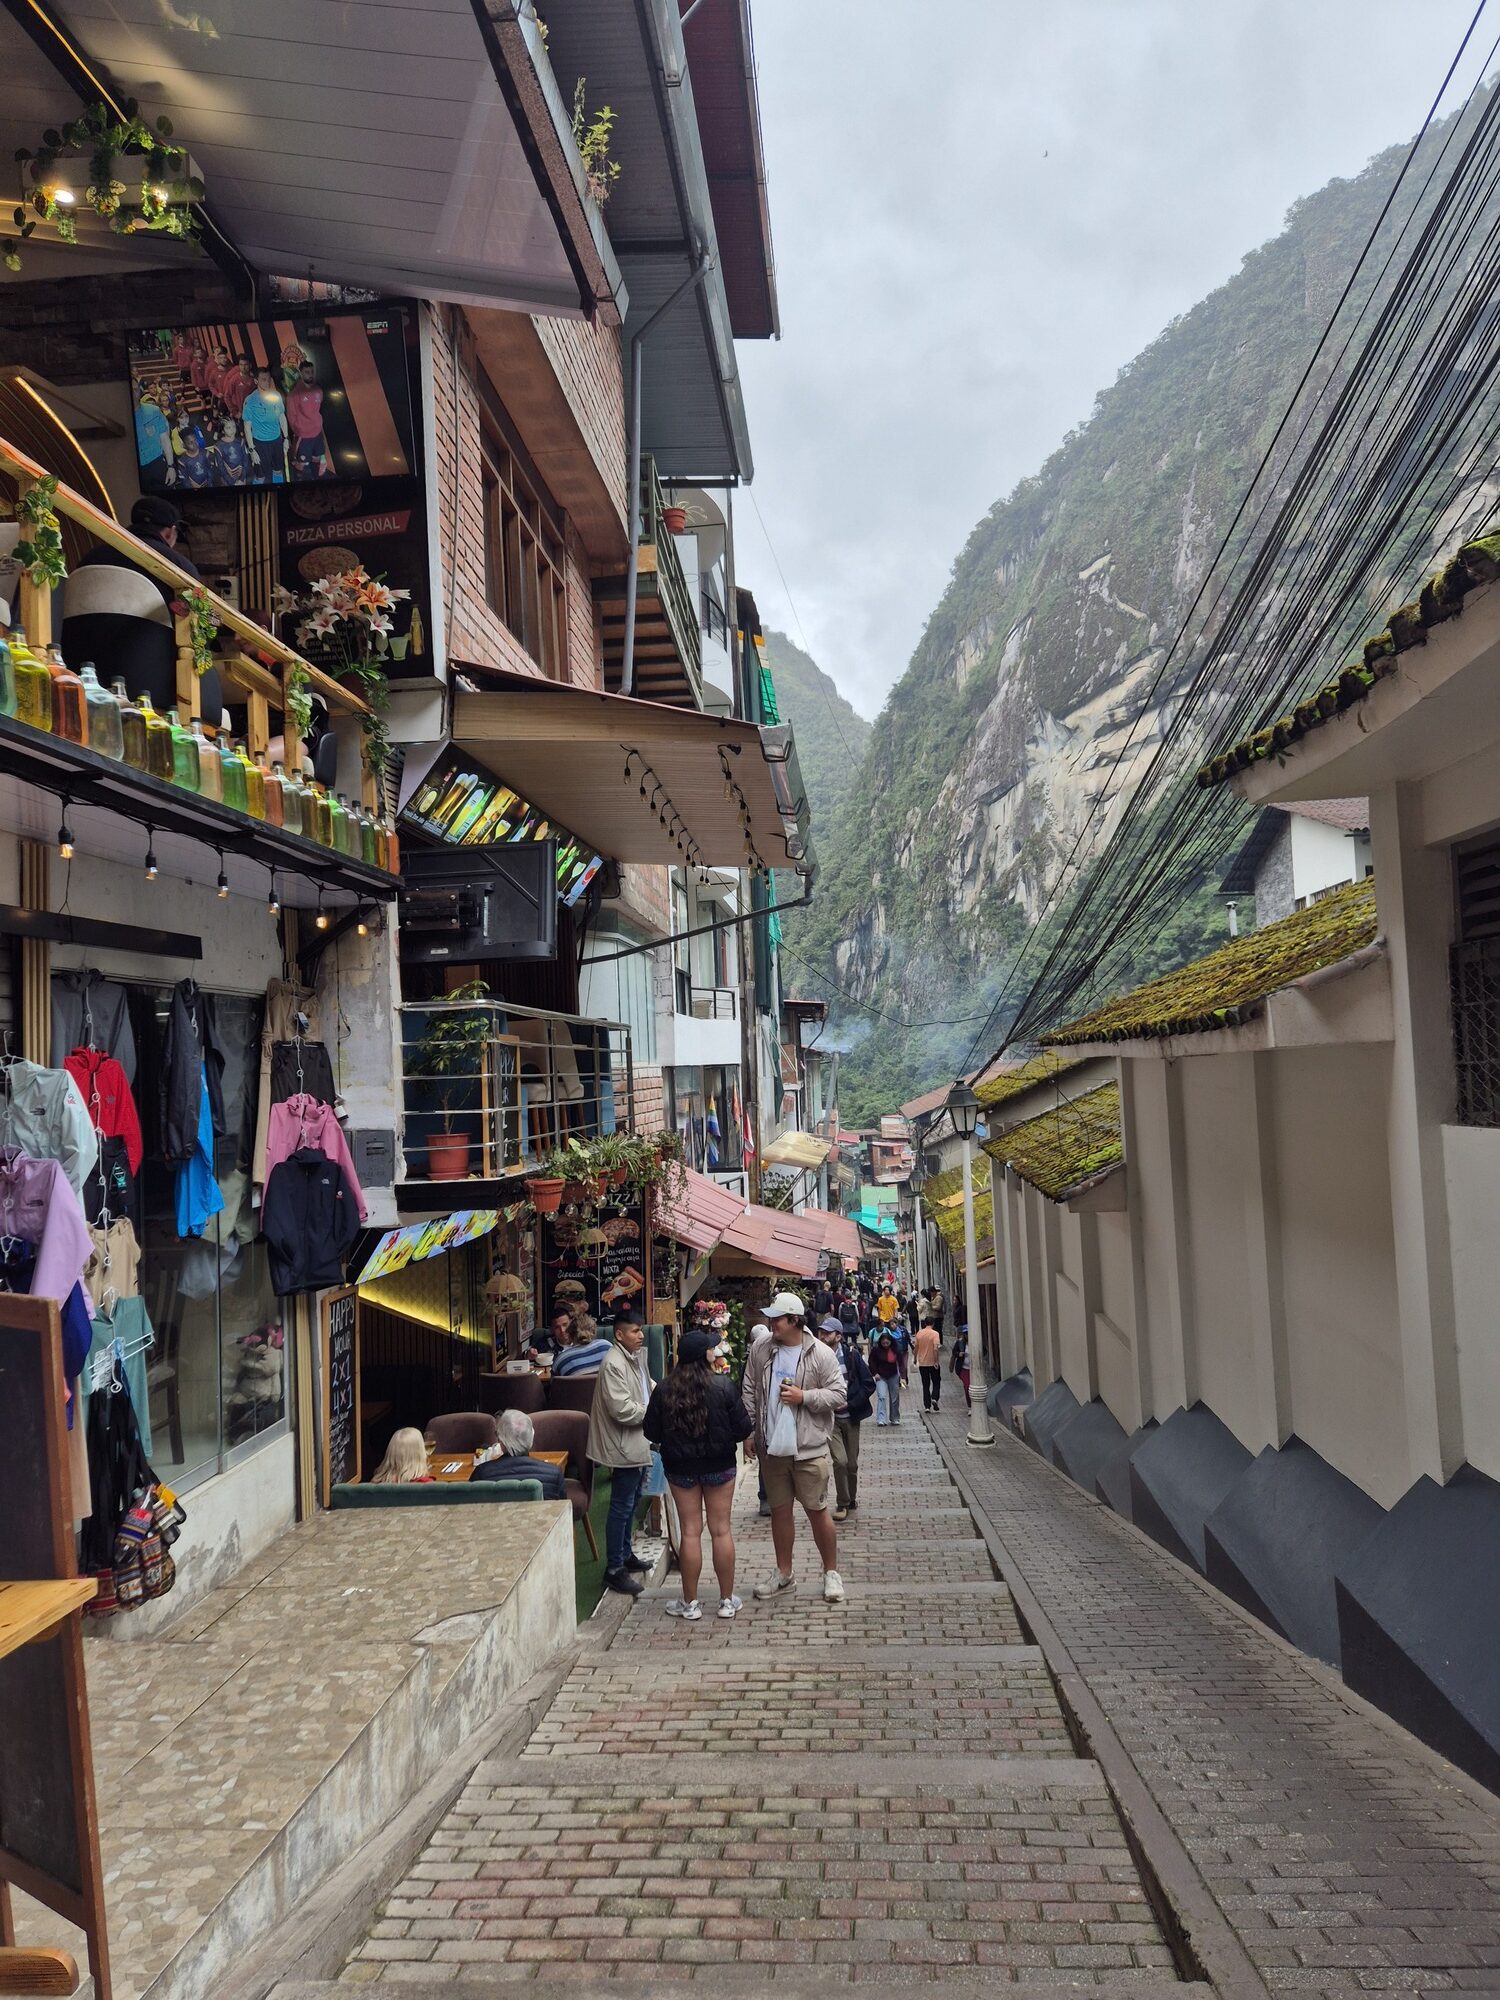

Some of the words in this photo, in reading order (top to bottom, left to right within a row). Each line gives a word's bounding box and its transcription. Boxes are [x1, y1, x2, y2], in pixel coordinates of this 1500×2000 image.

[366, 321, 388, 329] ESPN
[287, 527, 325, 544] PIZZA
[327, 516, 401, 538] PERSONAL
[329, 1294, 355, 1338] HAPPY
[334, 1330, 352, 1359] HOUR
